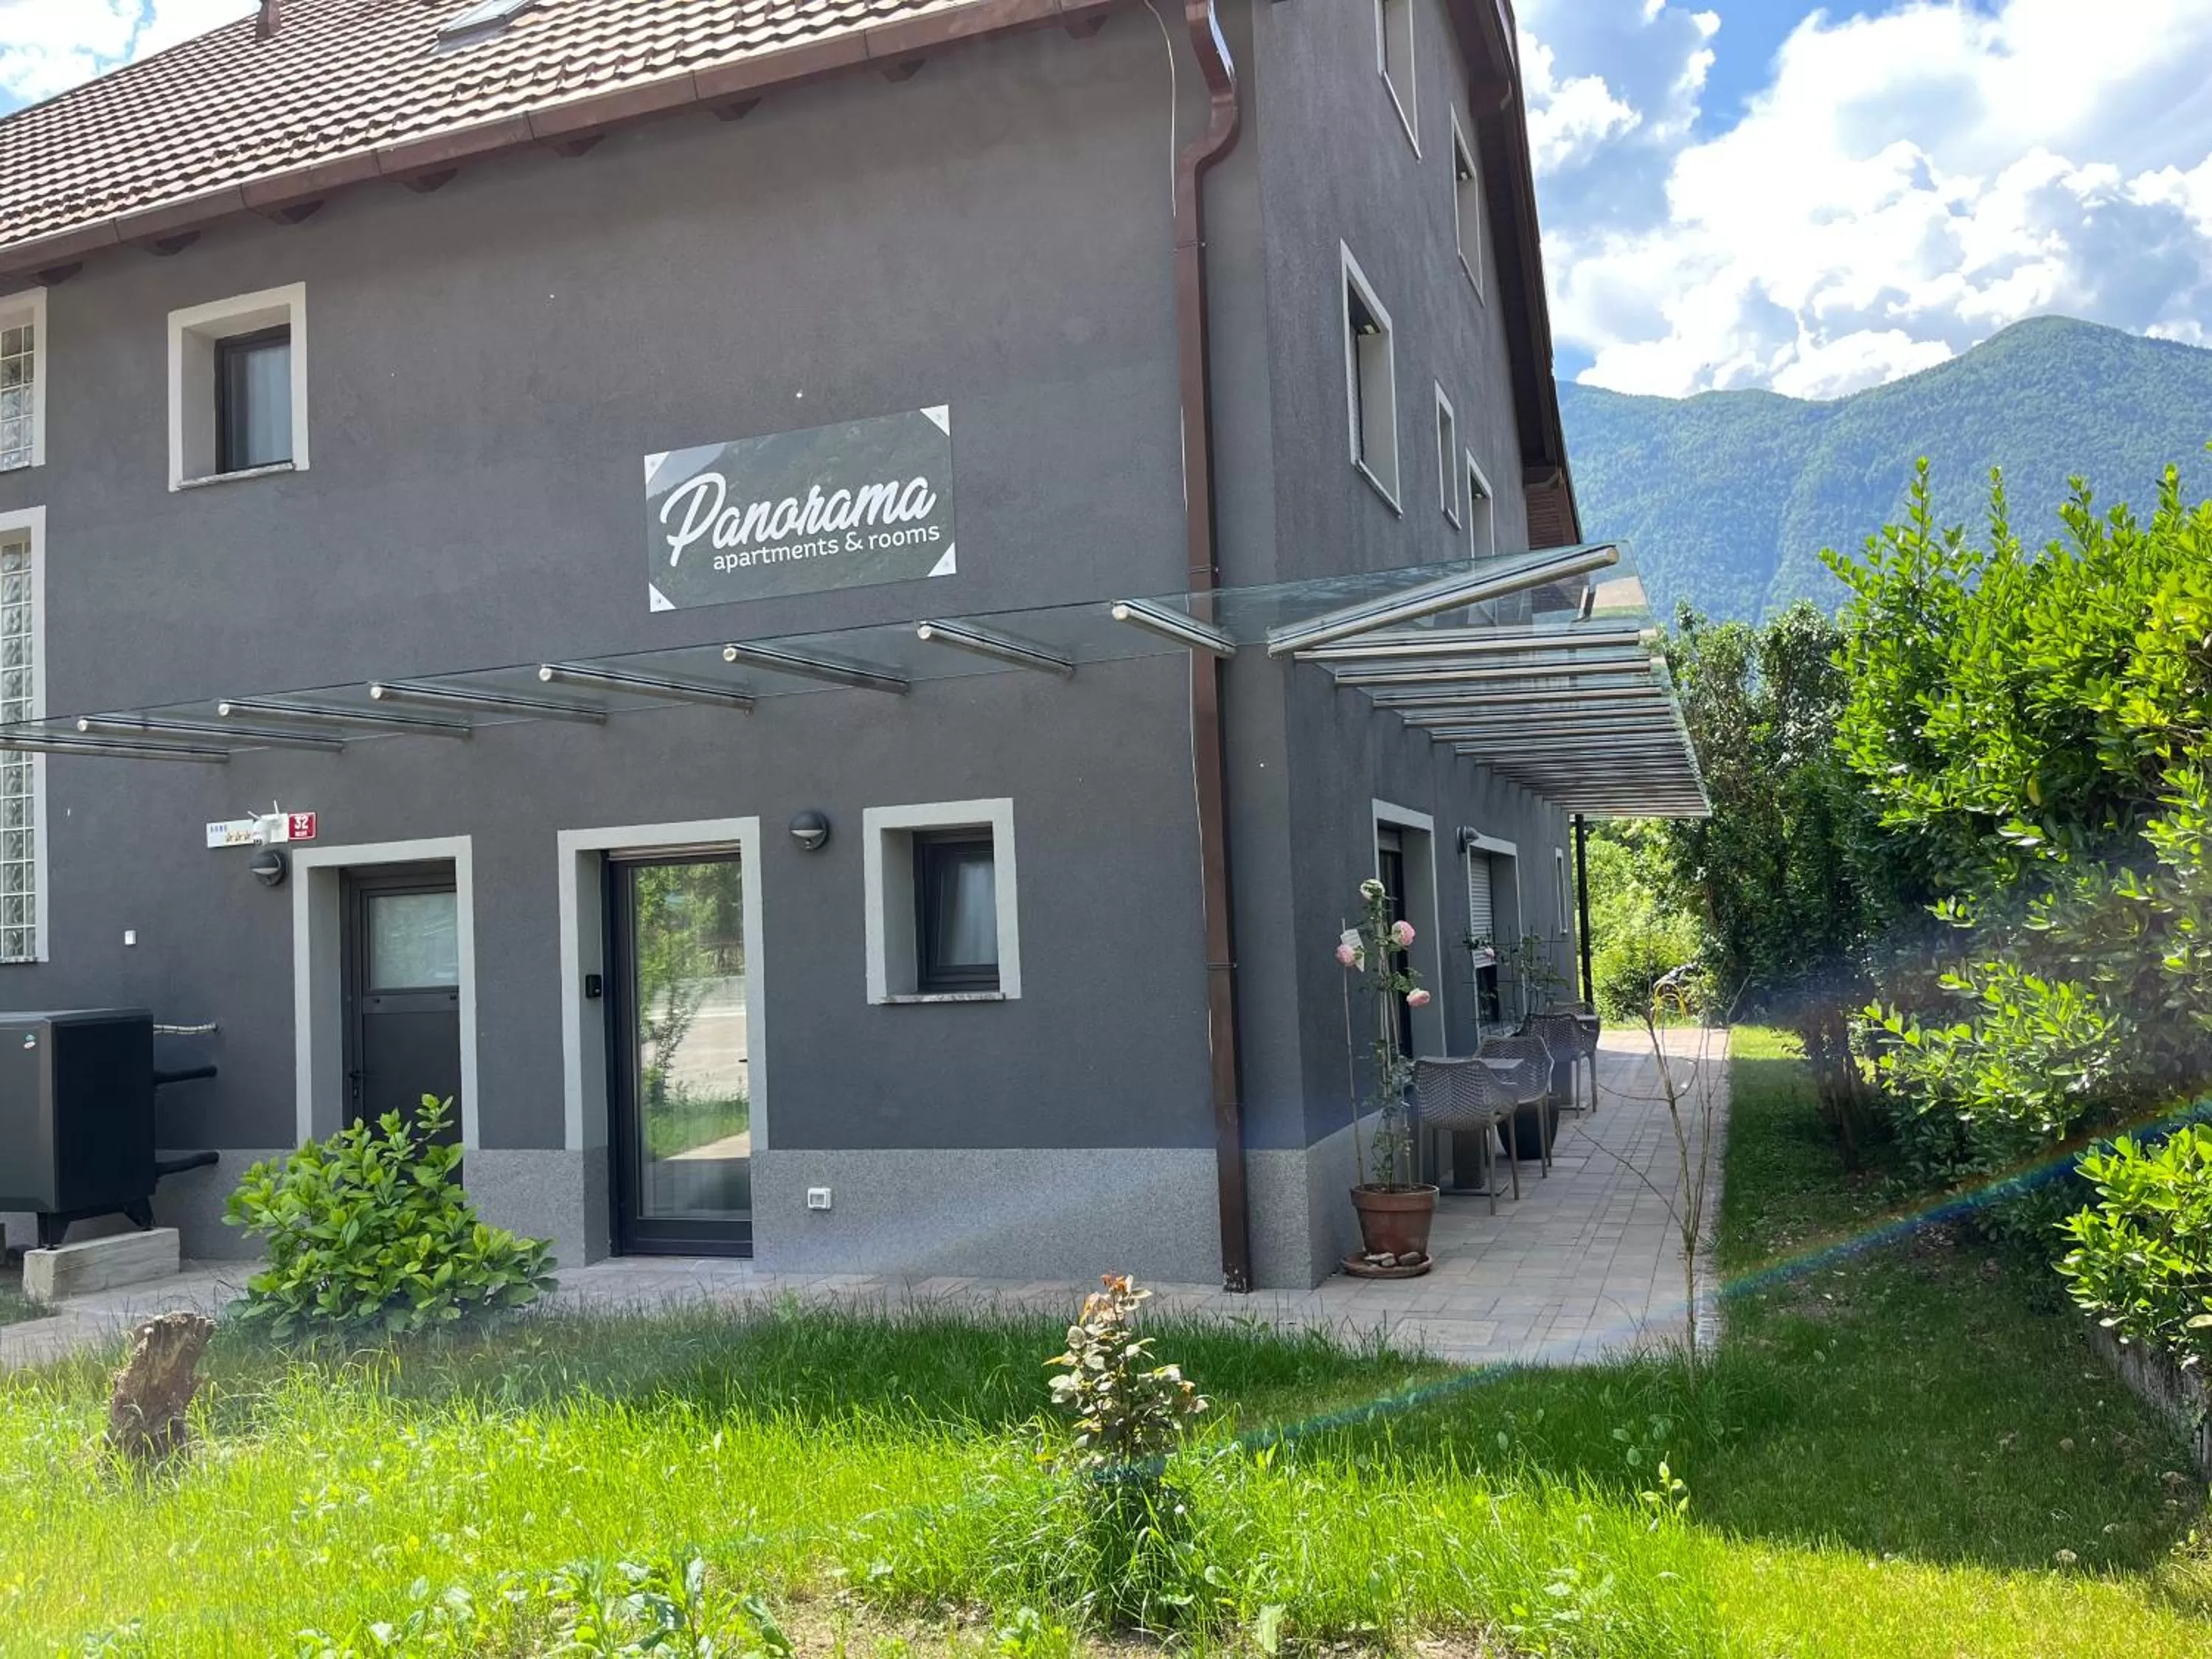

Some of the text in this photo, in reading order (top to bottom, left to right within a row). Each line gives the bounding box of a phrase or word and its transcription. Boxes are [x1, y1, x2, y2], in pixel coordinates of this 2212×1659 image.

[660, 473, 937, 567] Panorama
[713, 525, 940, 574] apartments & rooms
[294, 815, 309, 830] 32
